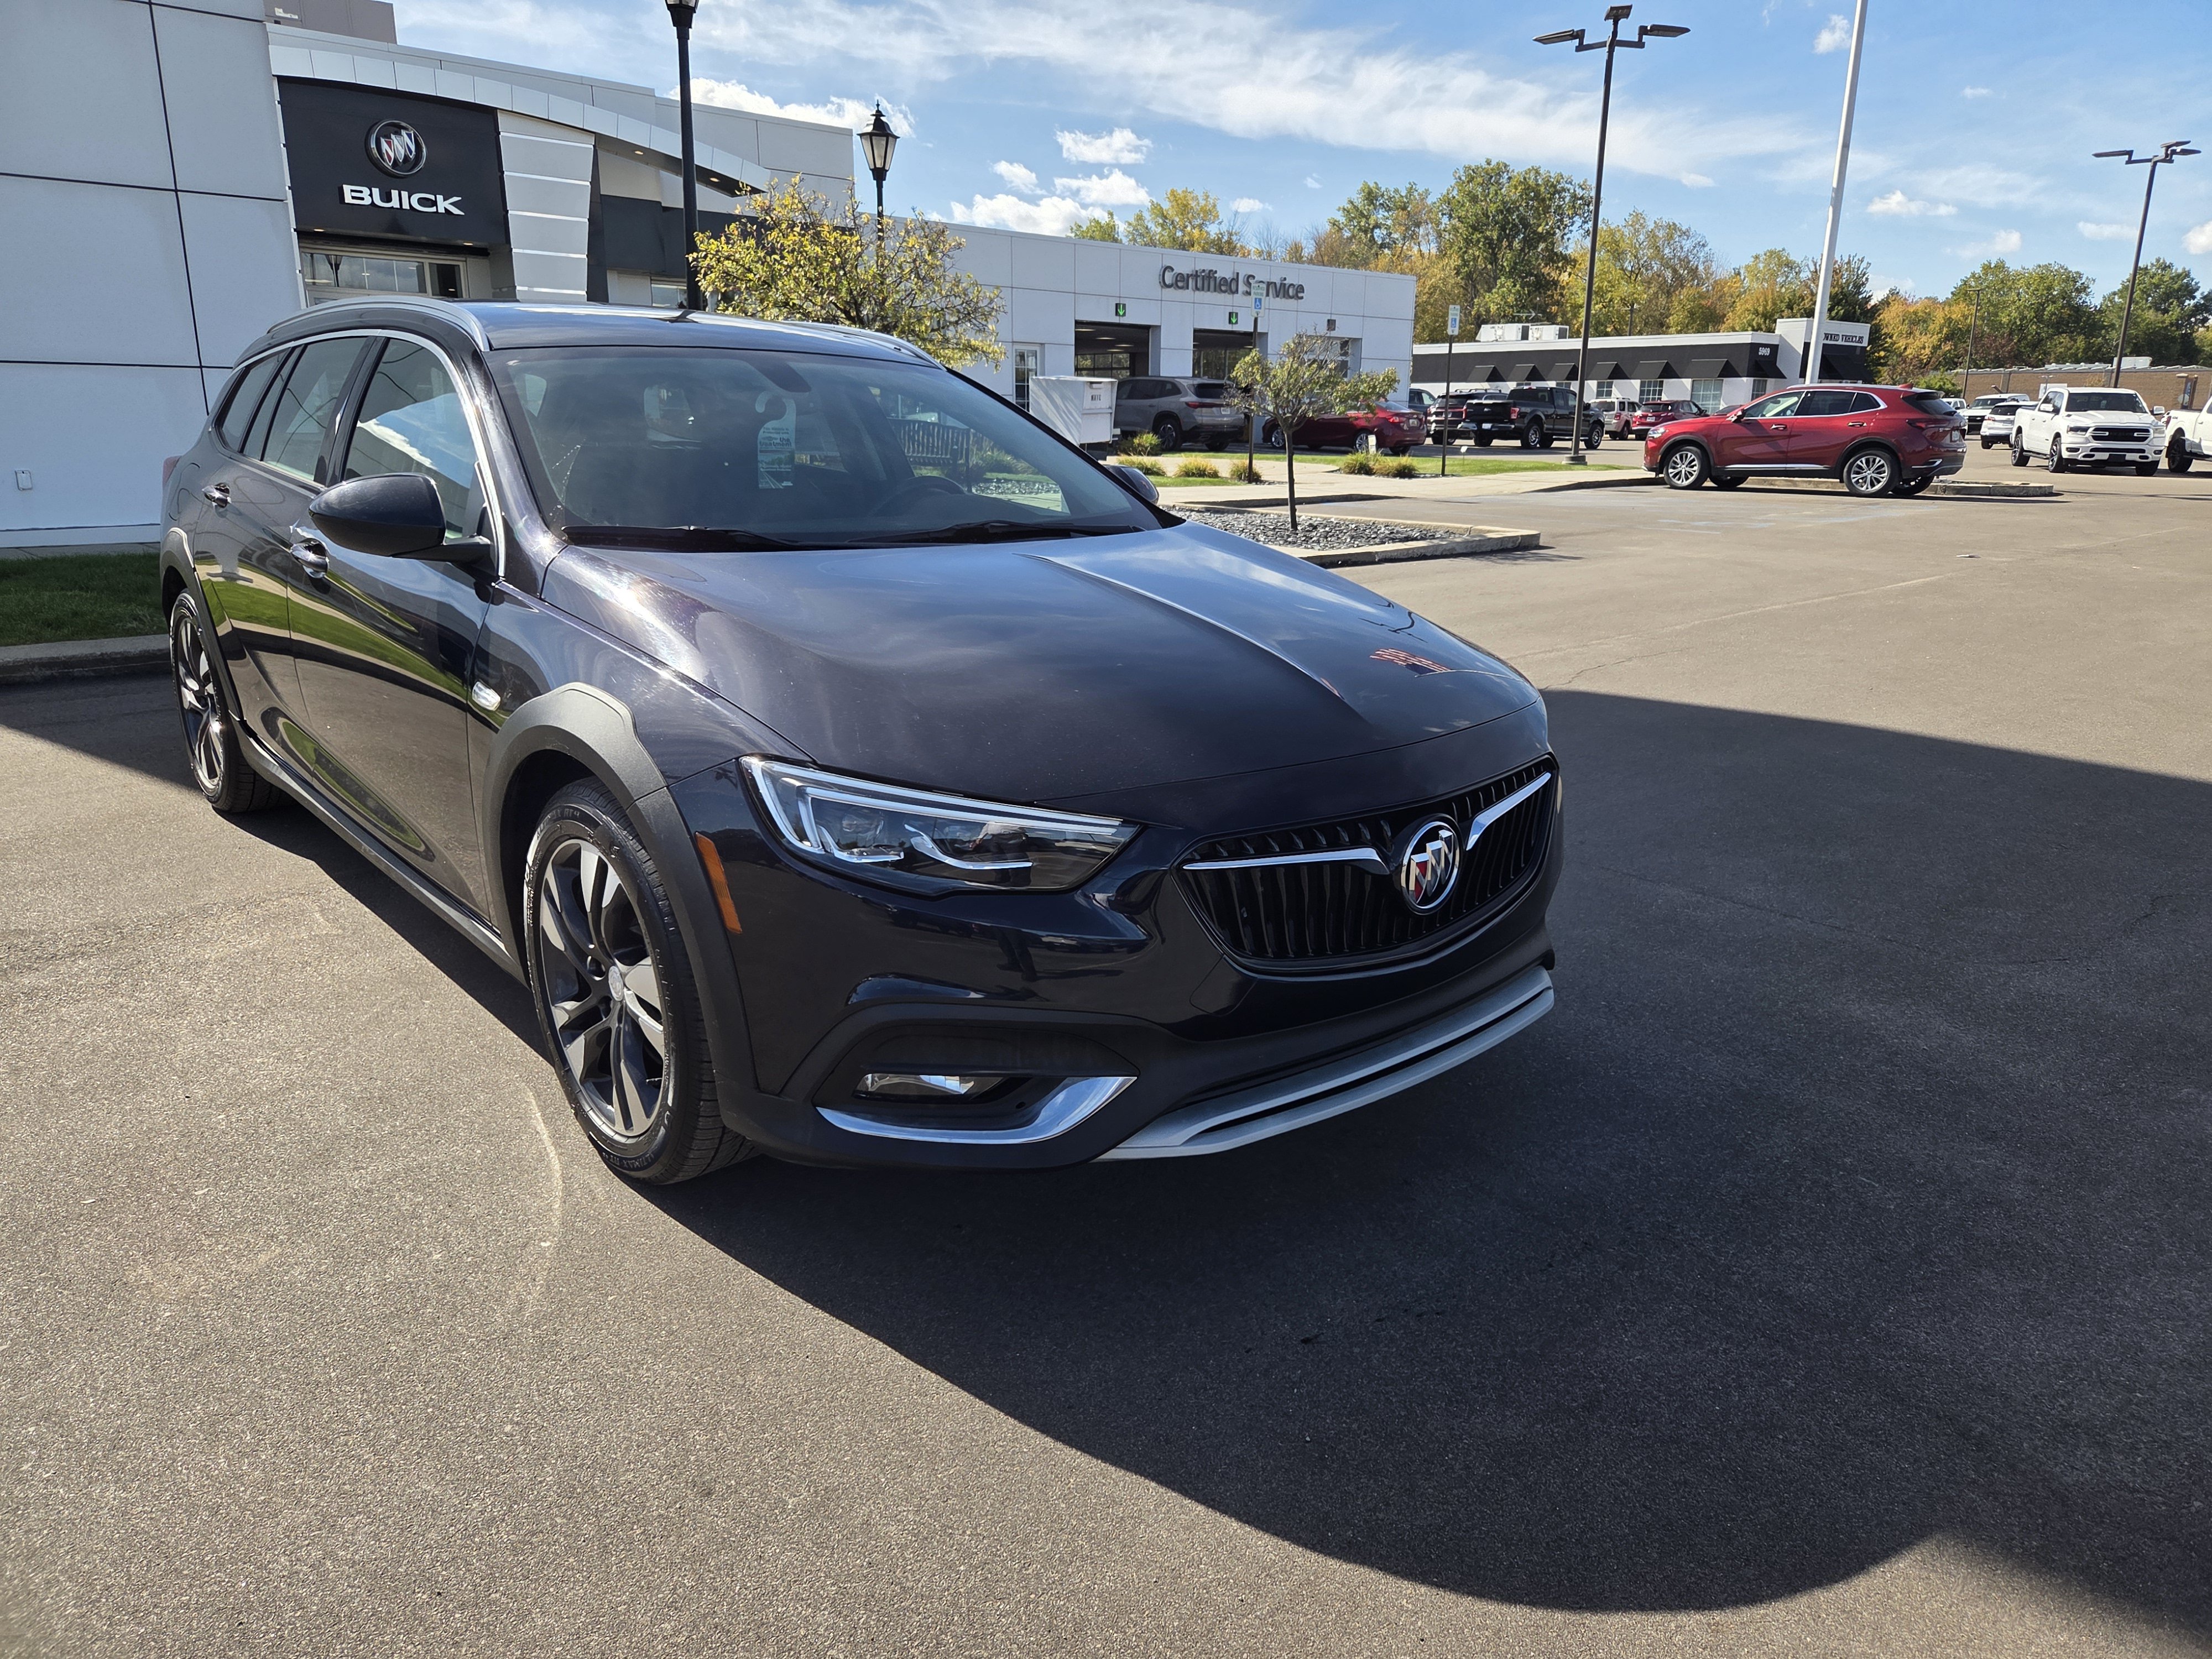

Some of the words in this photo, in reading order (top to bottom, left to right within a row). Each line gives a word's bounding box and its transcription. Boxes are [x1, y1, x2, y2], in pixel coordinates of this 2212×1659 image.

[342, 184, 465, 215] BUICK
[1160, 265, 1240, 294] Certified
[1243, 274, 1305, 300] Srvice
